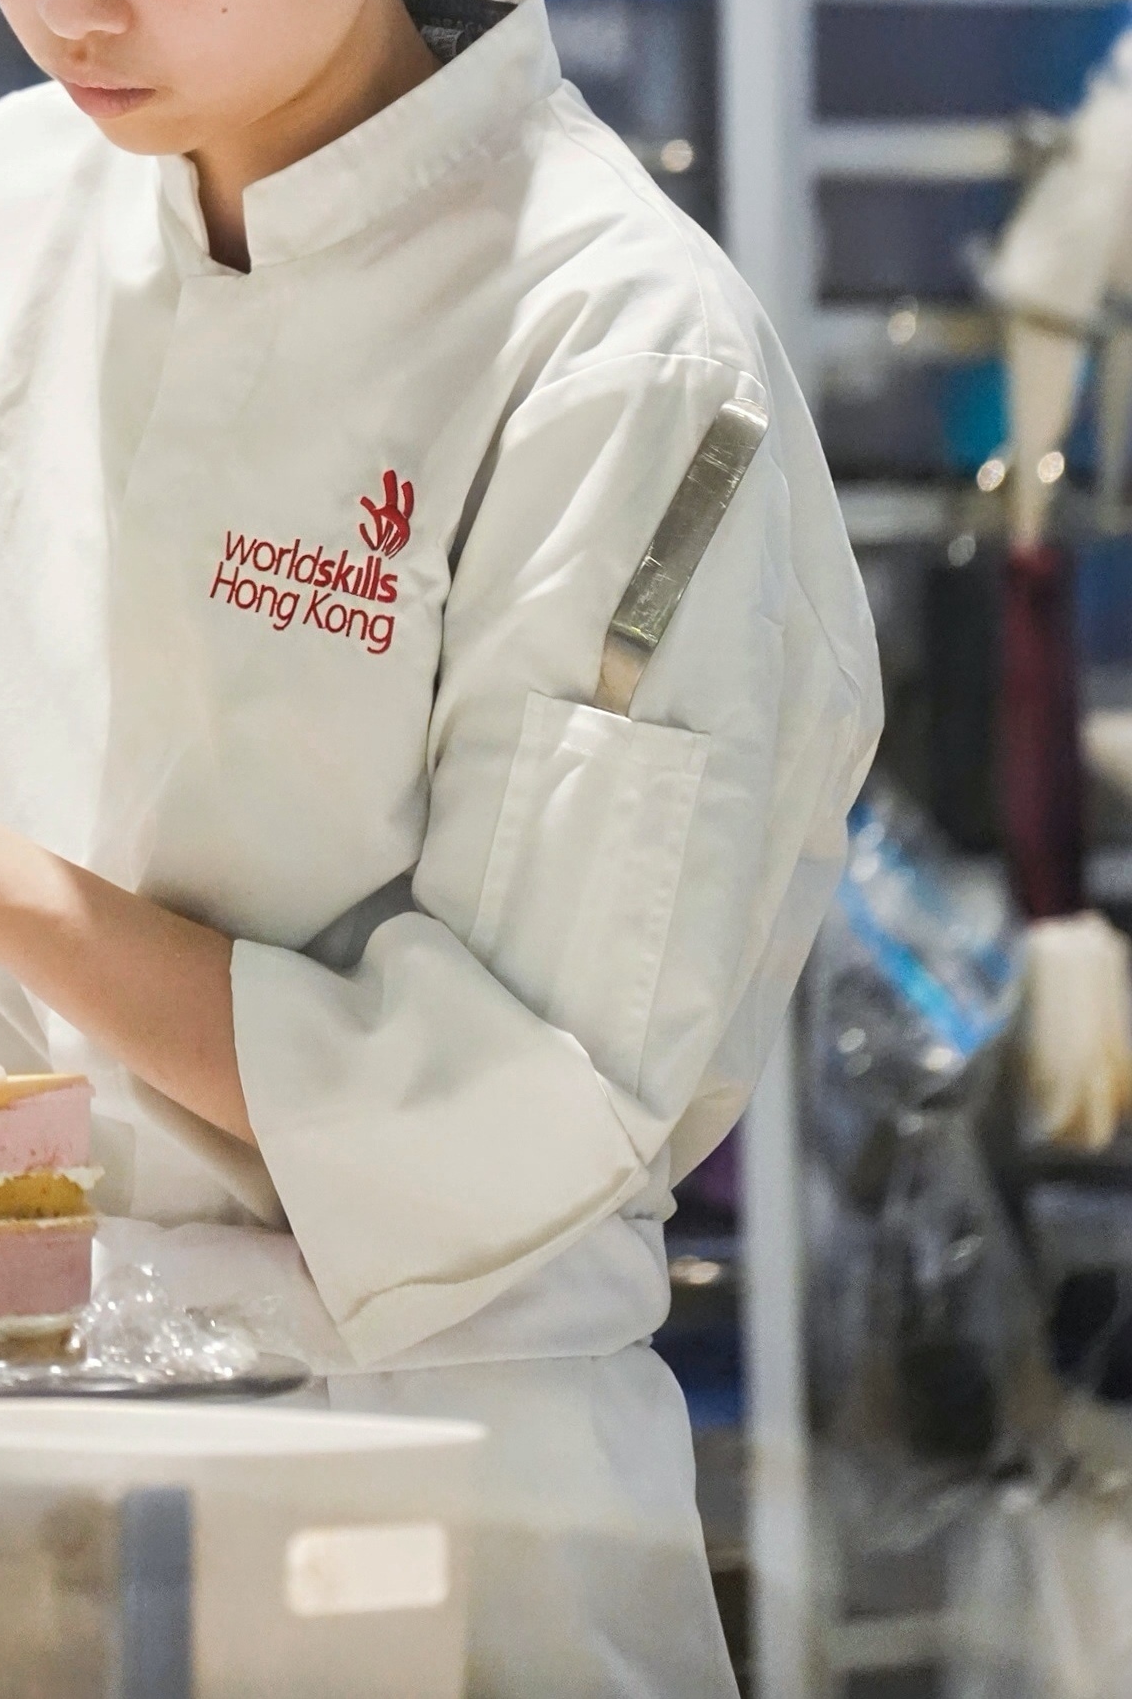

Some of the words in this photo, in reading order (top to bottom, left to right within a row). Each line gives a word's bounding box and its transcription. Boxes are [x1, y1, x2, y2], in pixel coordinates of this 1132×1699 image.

[209, 561, 300, 631] Hong
[302, 589, 395, 654] Kong
[225, 530, 398, 603] worldskills
